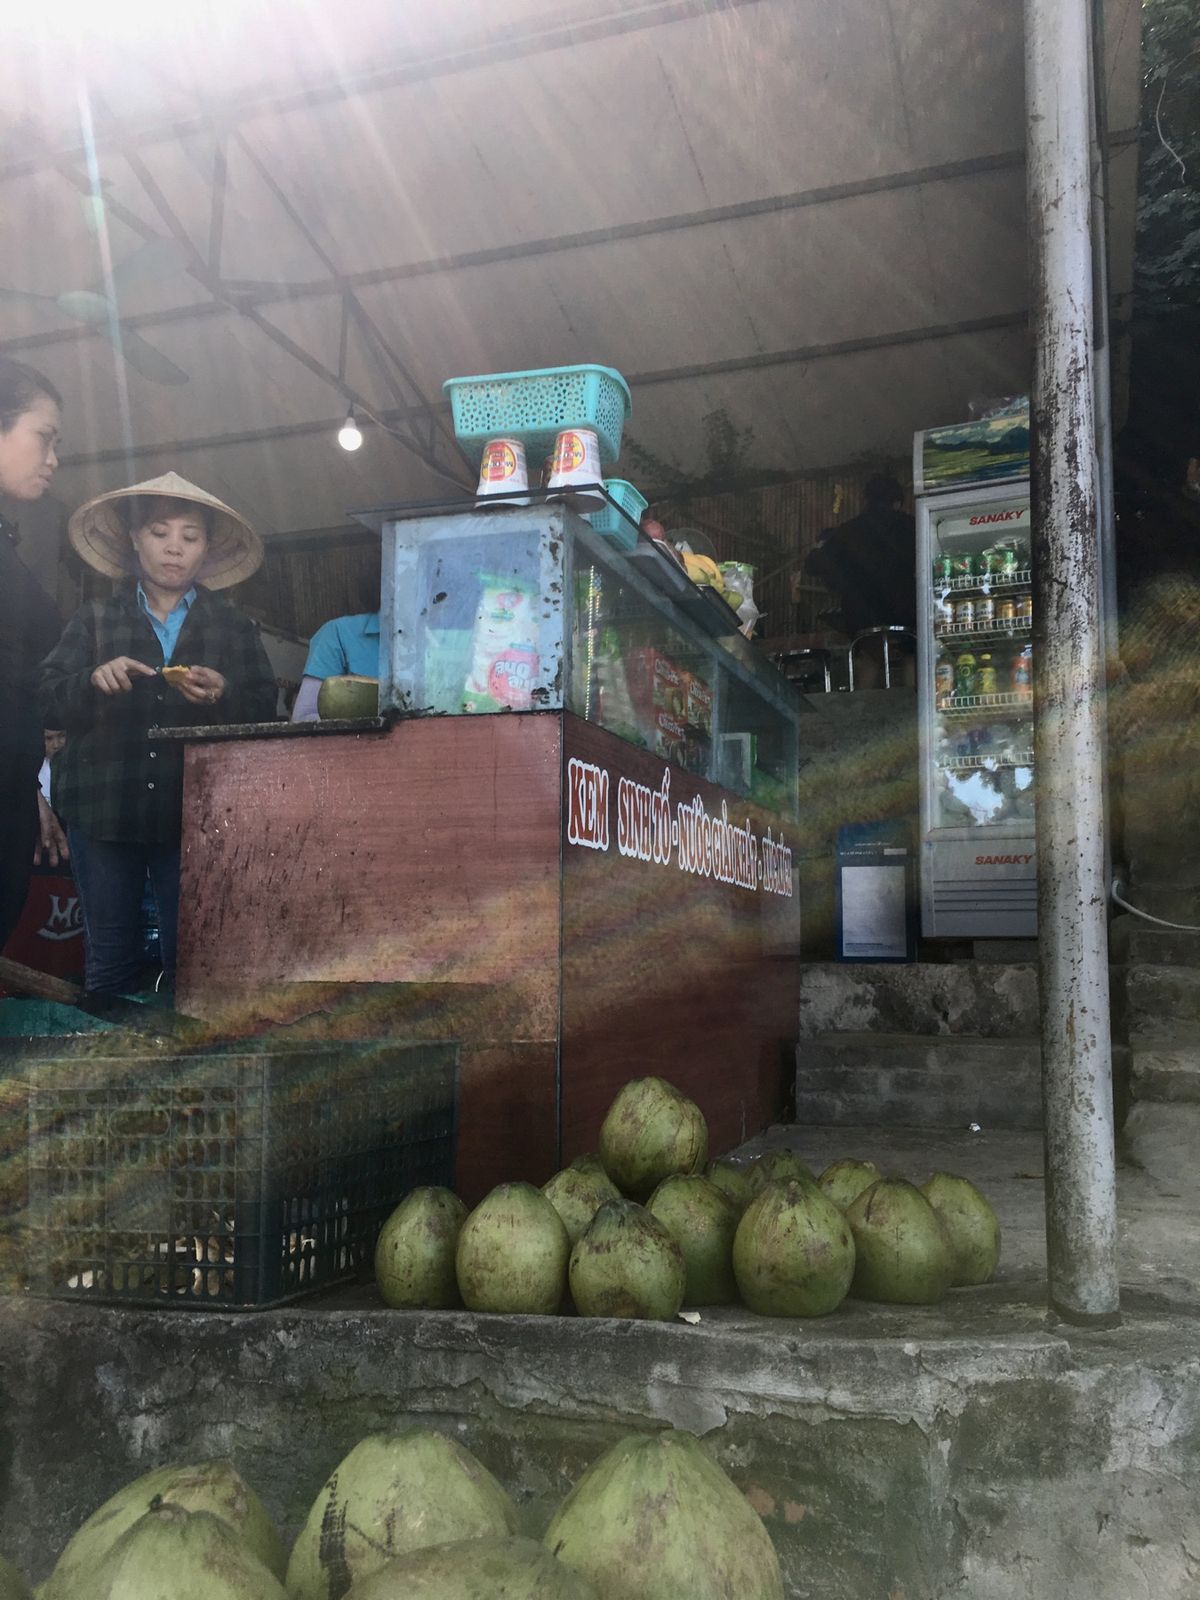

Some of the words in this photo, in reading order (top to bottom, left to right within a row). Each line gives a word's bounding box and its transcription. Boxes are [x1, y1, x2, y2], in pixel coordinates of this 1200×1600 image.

[969, 510, 1025, 526] SANAKY
[568, 757, 610, 851] KEM
[618, 776, 651, 862] SINH
[652, 767, 672, 865] TỐ
[678, 794, 711, 877] NƯỚC
[712, 800, 734, 884] GIẢI
[733, 818, 758, 891] KHÁT
[975, 854, 1032, 865] SANAKY
